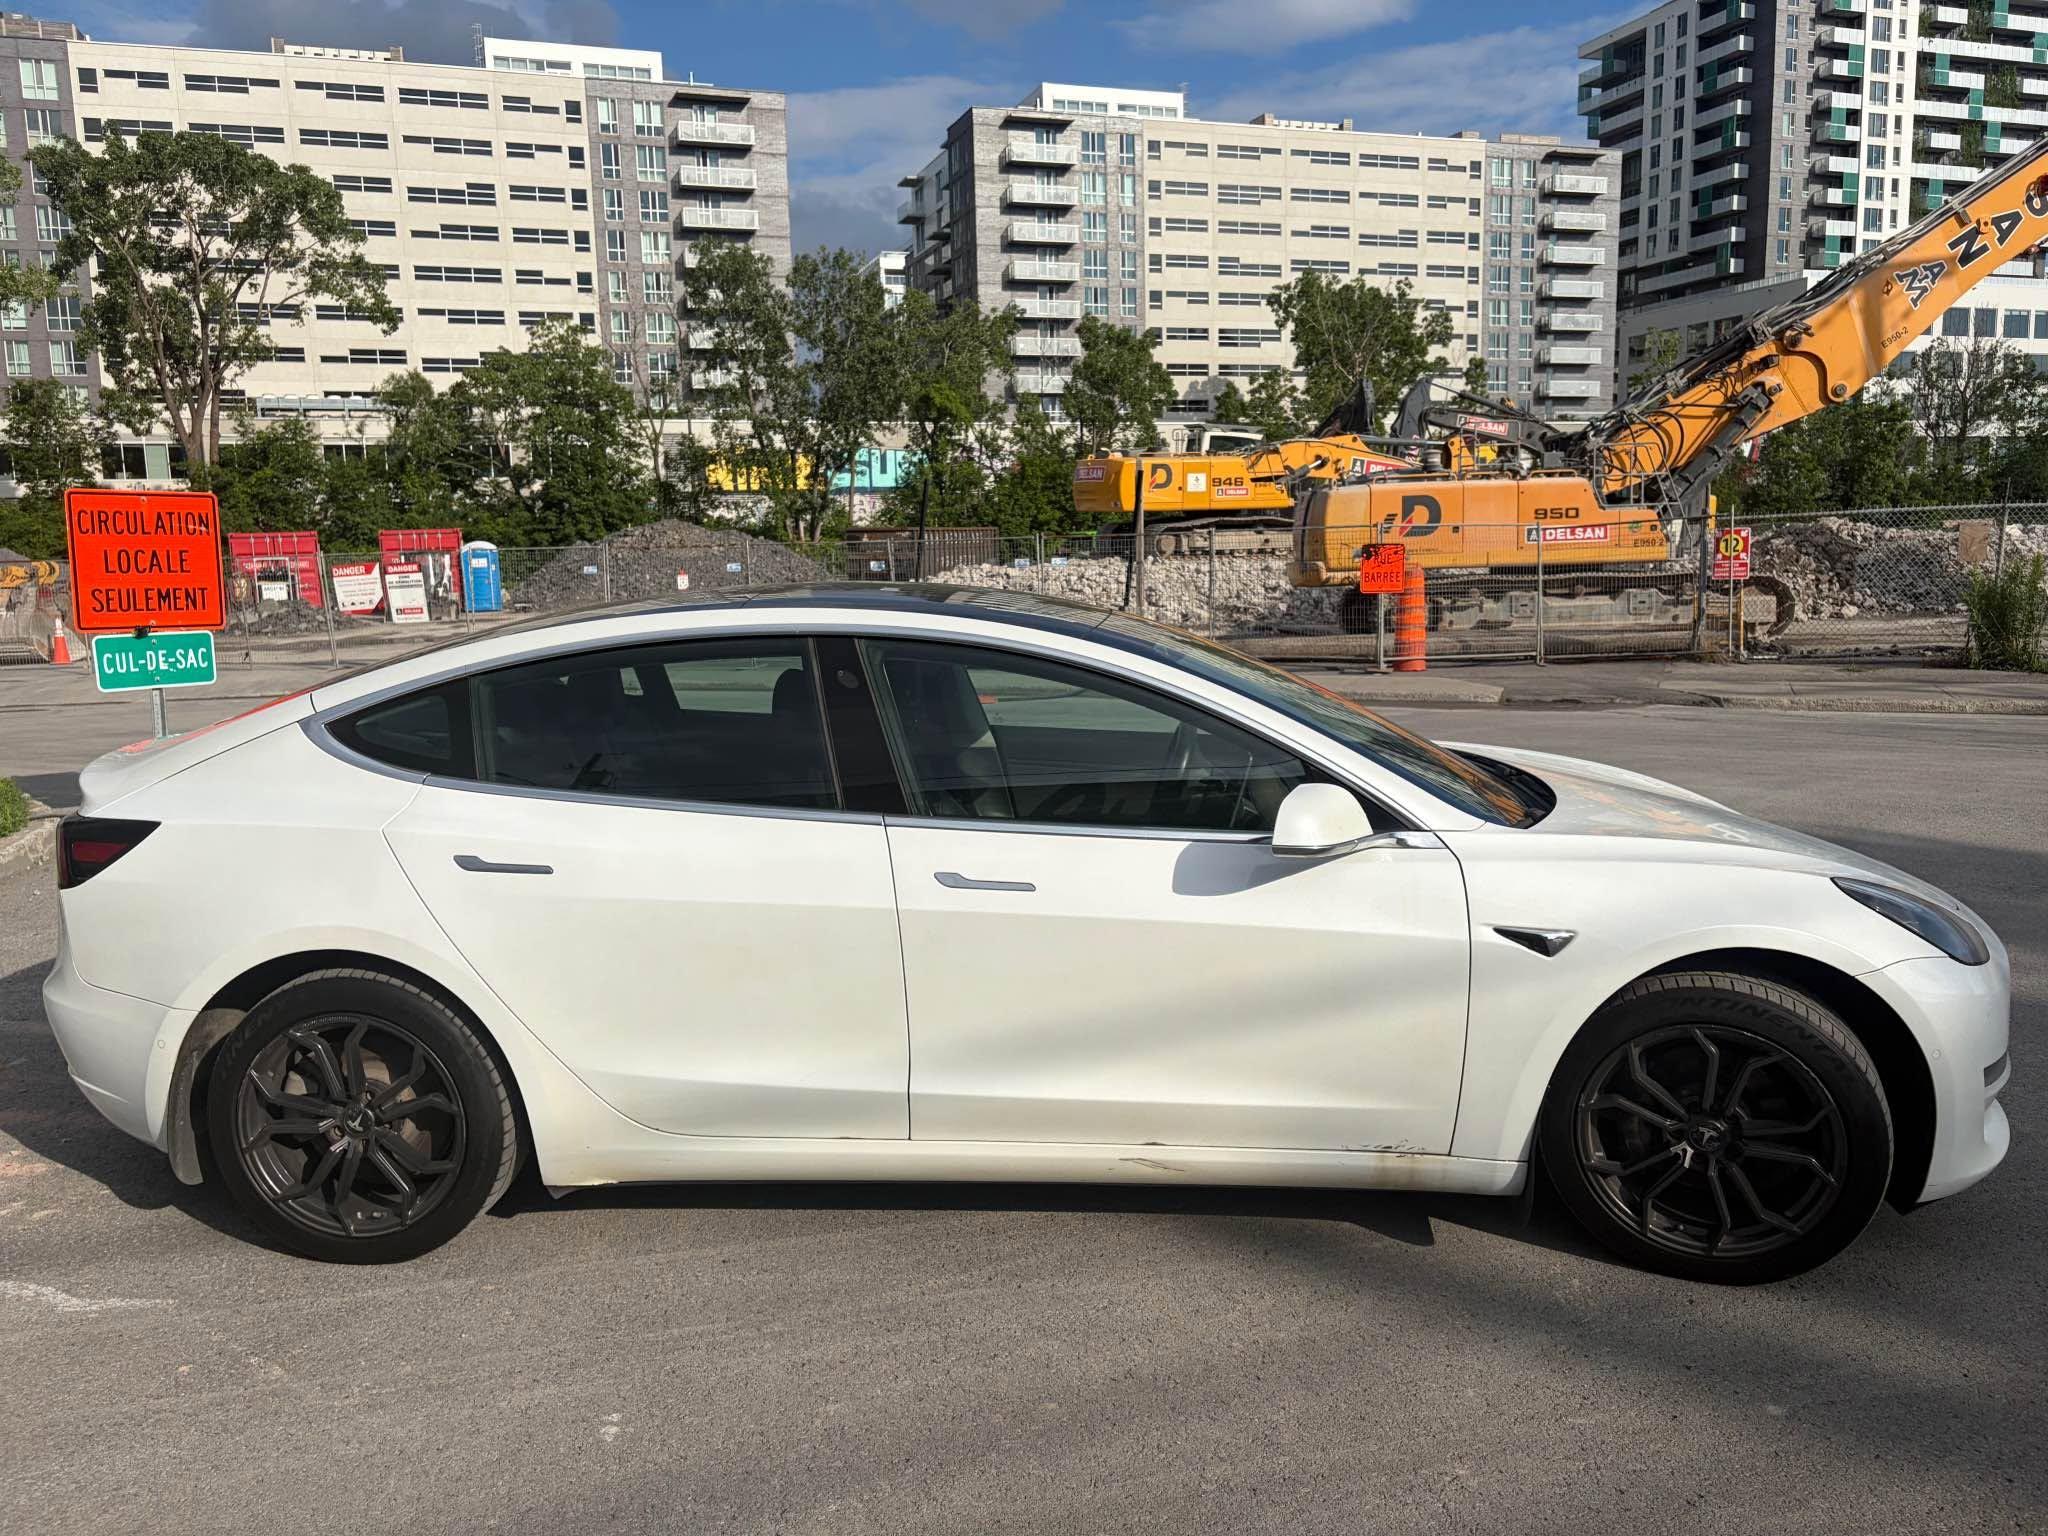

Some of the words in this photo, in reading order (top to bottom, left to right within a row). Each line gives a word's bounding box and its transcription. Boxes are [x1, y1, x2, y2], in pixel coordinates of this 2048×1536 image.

[1212, 477, 1244, 487] 946
[1534, 508, 1579, 519] 950
[77, 510, 210, 536] CIRCULATION
[1546, 526, 1605, 540] DELSAN
[1723, 538, 1740, 553] 12
[103, 549, 191, 574] LOCALE
[388, 564, 418, 573] DANGER
[332, 565, 366, 577] DANGER
[91, 588, 208, 613] SEULEMENT
[103, 648, 208, 673] CUL-DE-SAC
